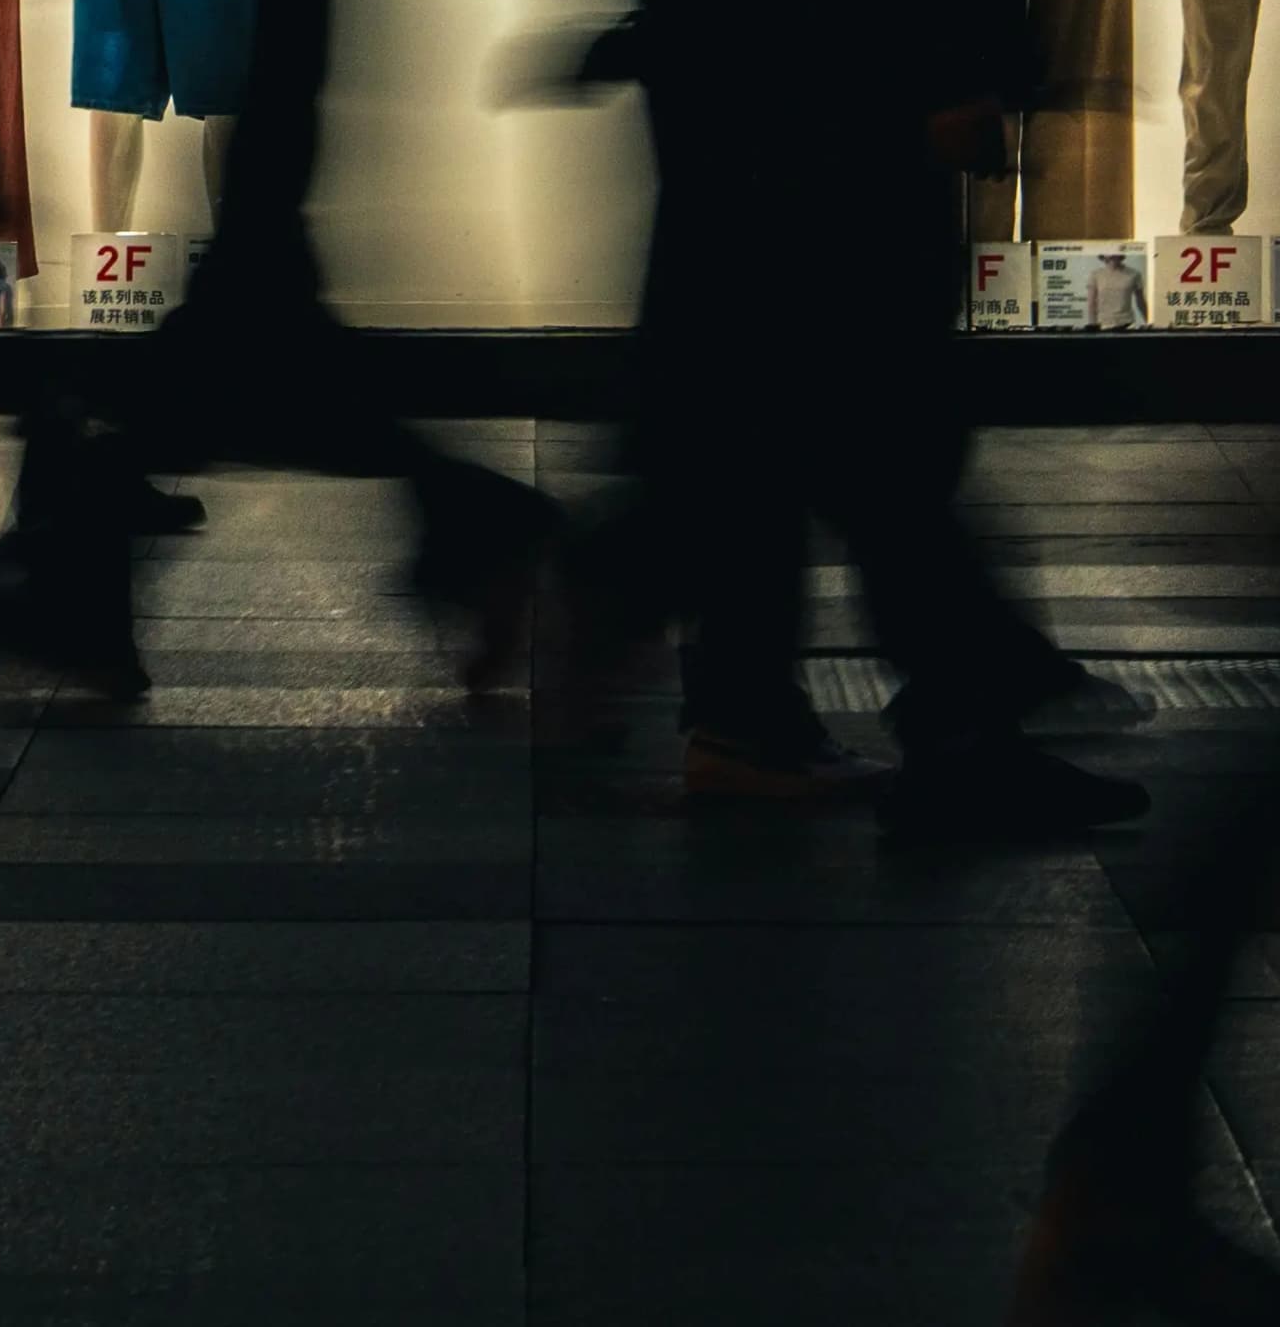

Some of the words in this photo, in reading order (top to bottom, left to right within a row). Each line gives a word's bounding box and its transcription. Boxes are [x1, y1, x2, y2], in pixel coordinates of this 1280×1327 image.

[97, 245, 152, 282] 2F
[1180, 247, 1237, 283] 2F
[82, 290, 165, 305] 该系列商品
[1166, 291, 1250, 307] 该系列商品
[90, 309, 155, 324] 展开销售
